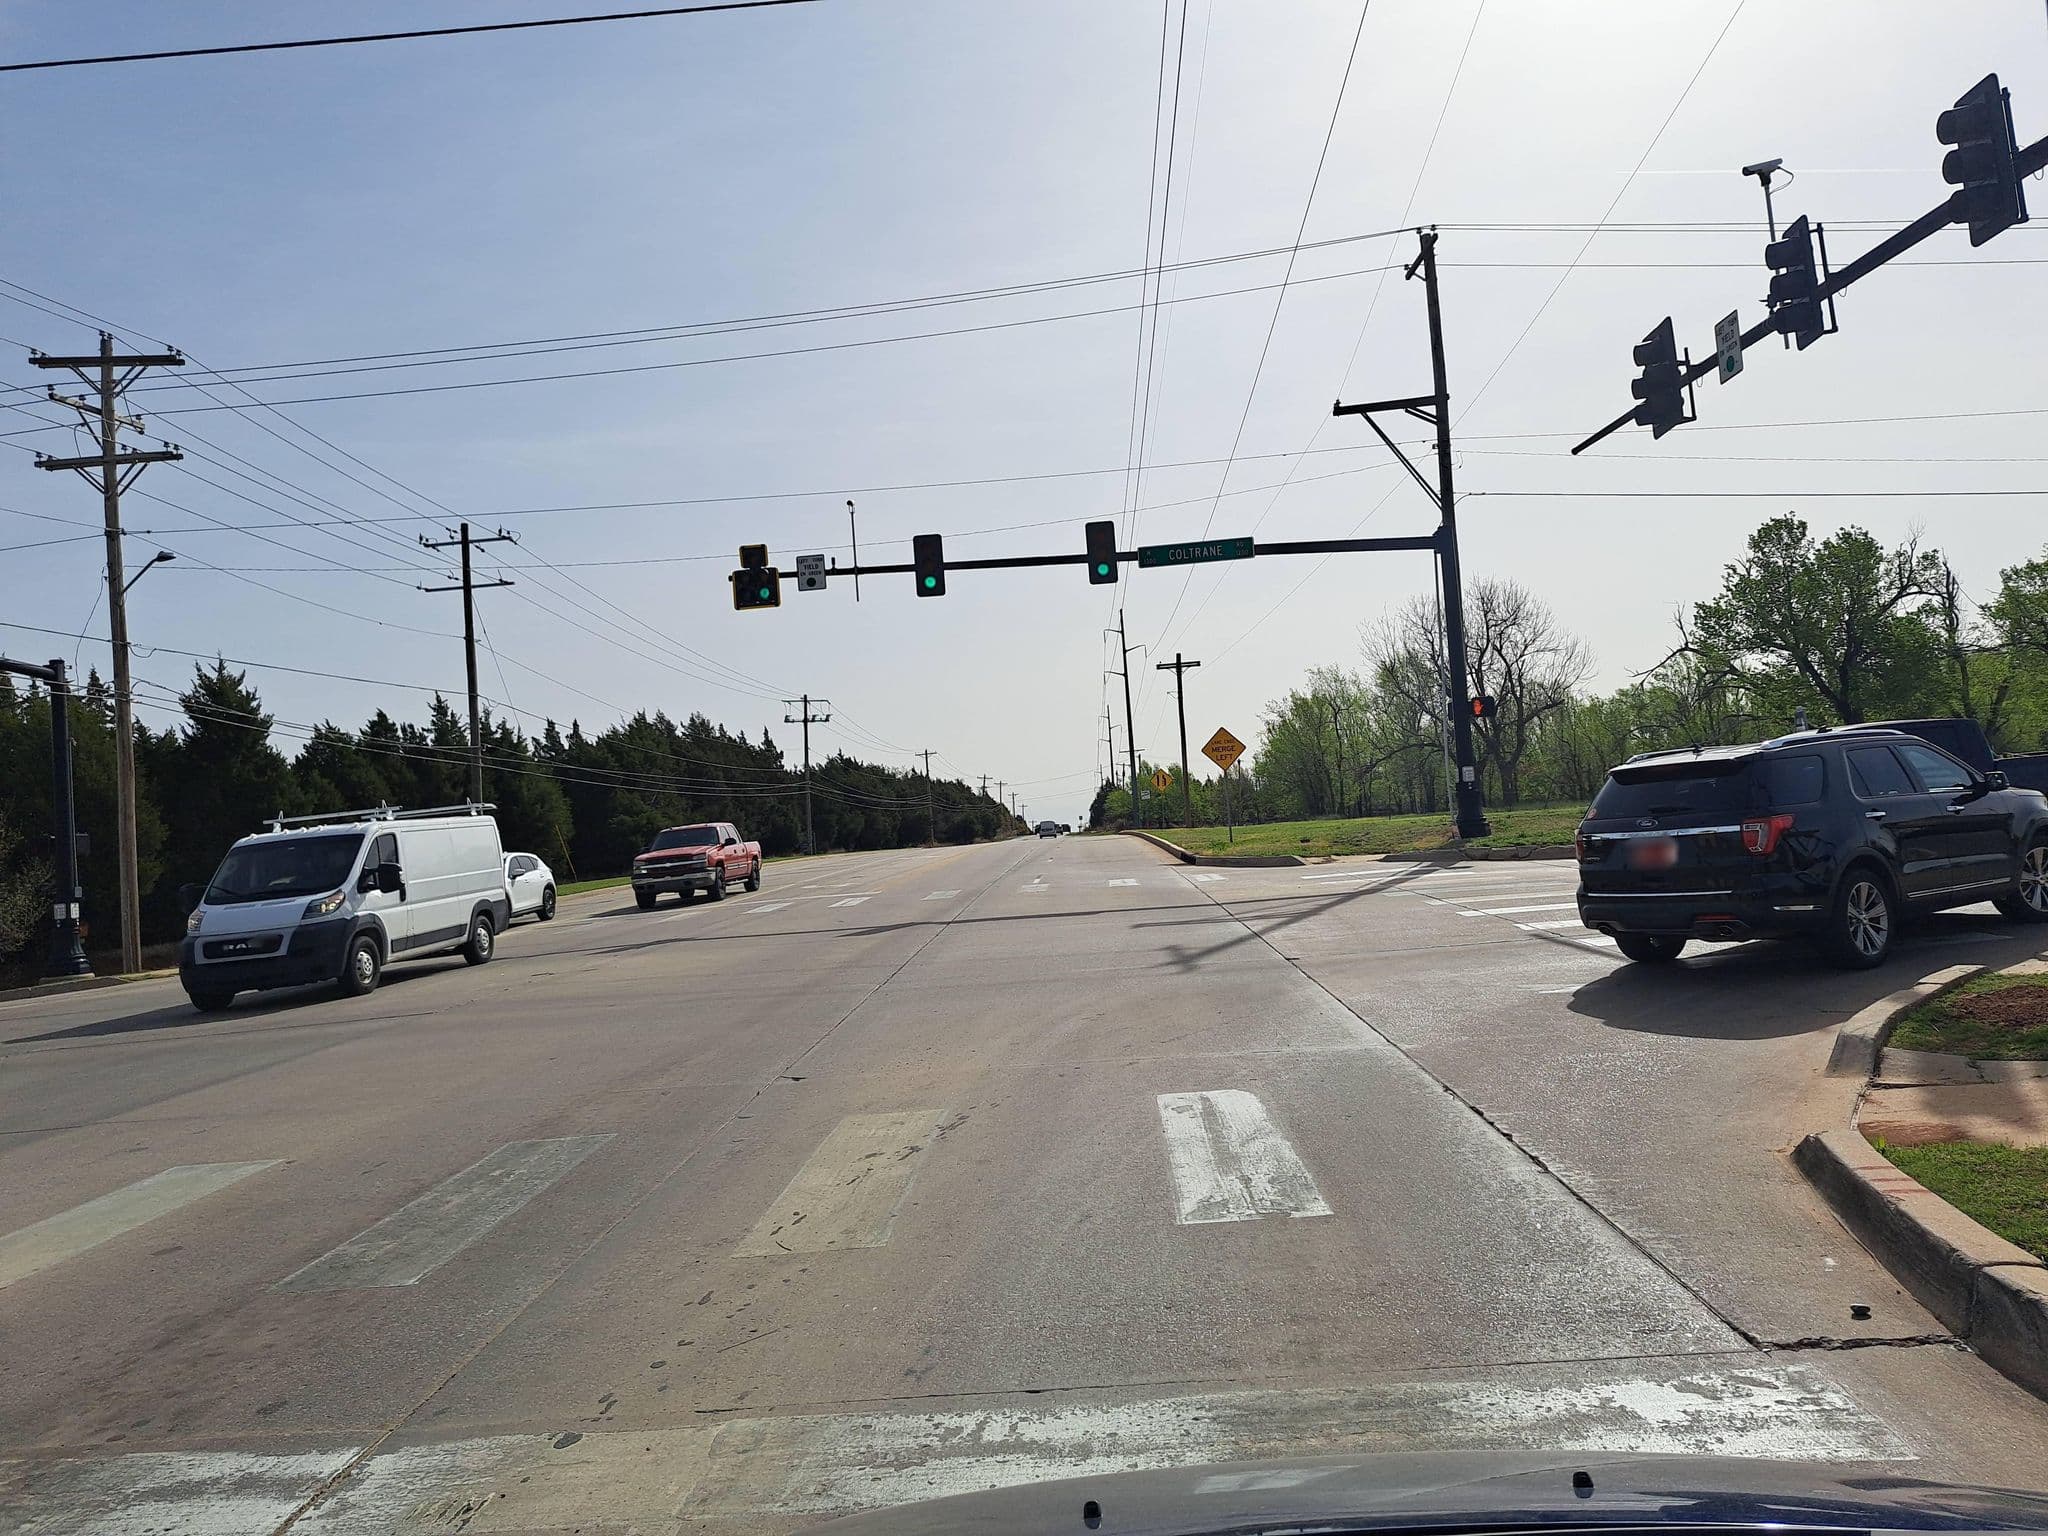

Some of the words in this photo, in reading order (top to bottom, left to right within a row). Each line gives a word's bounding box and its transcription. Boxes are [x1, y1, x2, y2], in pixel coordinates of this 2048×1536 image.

[1168, 545, 1223, 560] COLTRANE
[1211, 745, 1236, 753] MERGE
[1216, 753, 1233, 761] LEFT
